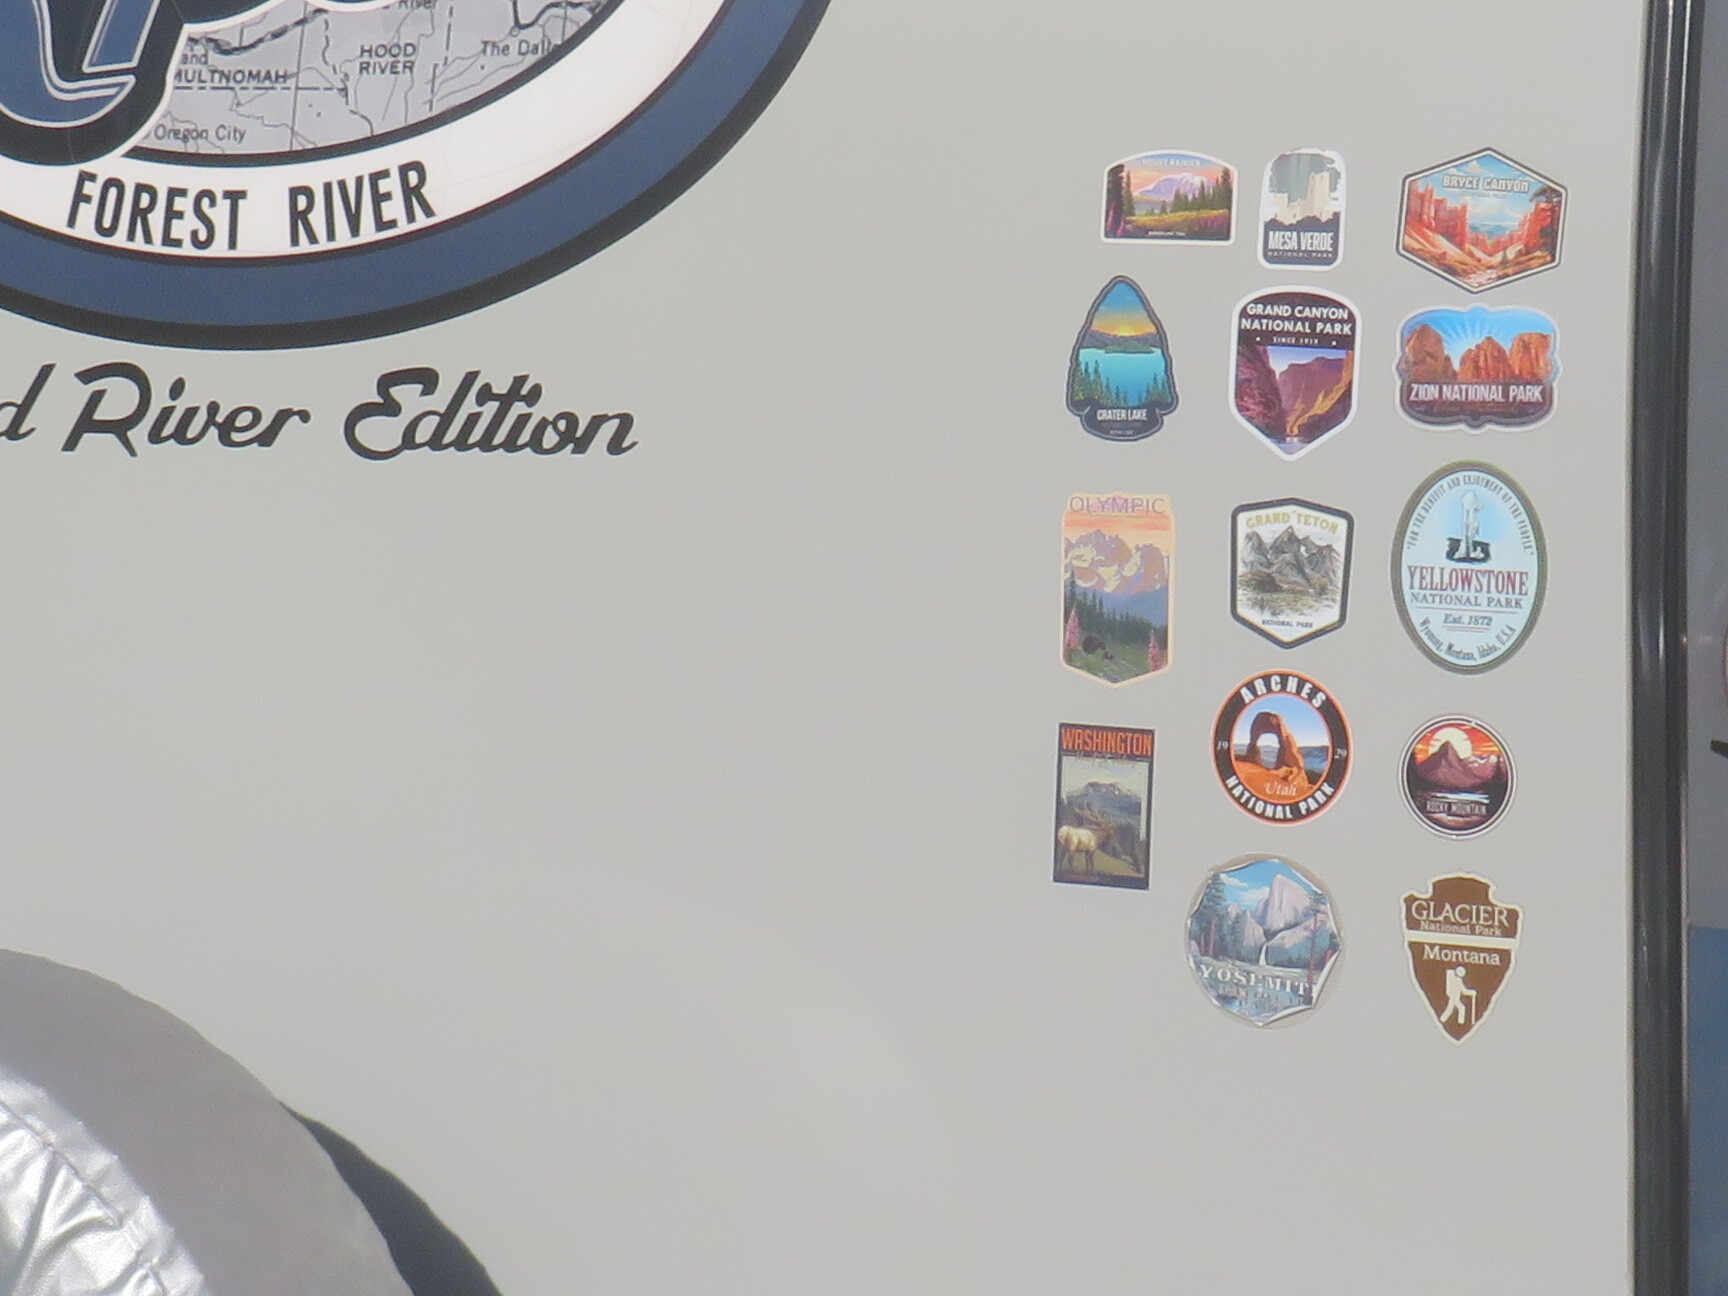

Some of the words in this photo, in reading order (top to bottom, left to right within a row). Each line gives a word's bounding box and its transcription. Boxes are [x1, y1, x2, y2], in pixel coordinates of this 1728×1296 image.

[360, 43, 416, 59] HOOD
[482, 40, 510, 56] The
[359, 60, 415, 75] RIVER
[154, 124, 208, 143] Oregon
[215, 125, 247, 143] City
[1442, 175, 1480, 190] BRYCE
[1483, 177, 1530, 193] CANYON
[66, 168, 248, 251] FOREST
[288, 158, 437, 248] RIVER
[1268, 231, 1298, 250] MESA
[1300, 232, 1334, 251] VERDE
[1246, 303, 1291, 317] GRAND
[1294, 305, 1348, 320] CANYON
[1241, 318, 1311, 333] NATIONAL
[1316, 321, 1352, 335] PARK
[1409, 383, 1439, 401] ZION
[1443, 384, 1505, 402] NATIONAL
[1509, 385, 1543, 402] PARK
[60, 360, 310, 458] River
[343, 366, 638, 461] Edition
[1096, 408, 1127, 421] CRATER
[1128, 408, 1148, 421] LAKE
[1069, 495, 1165, 514] OLYMPIC
[1245, 512, 1290, 528] GRAND
[1297, 513, 1340, 534] TETON
[1407, 565, 1529, 596] YELLOWSTONE
[1410, 593, 1481, 607] NATIONAL
[1487, 596, 1523, 609] PARK
[1467, 615, 1493, 626] 1872
[1240, 674, 1327, 708] ARCHES
[1061, 728, 1153, 757] WASHINGTON
[1225, 775, 1293, 819] NATIONAL
[1299, 782, 1334, 815] PARK
[1264, 781, 1297, 796] Utah
[1412, 900, 1509, 927] GLACIER
[1420, 920, 1471, 934] National
[1475, 924, 1502, 936] Park
[1423, 944, 1501, 965] Montana
